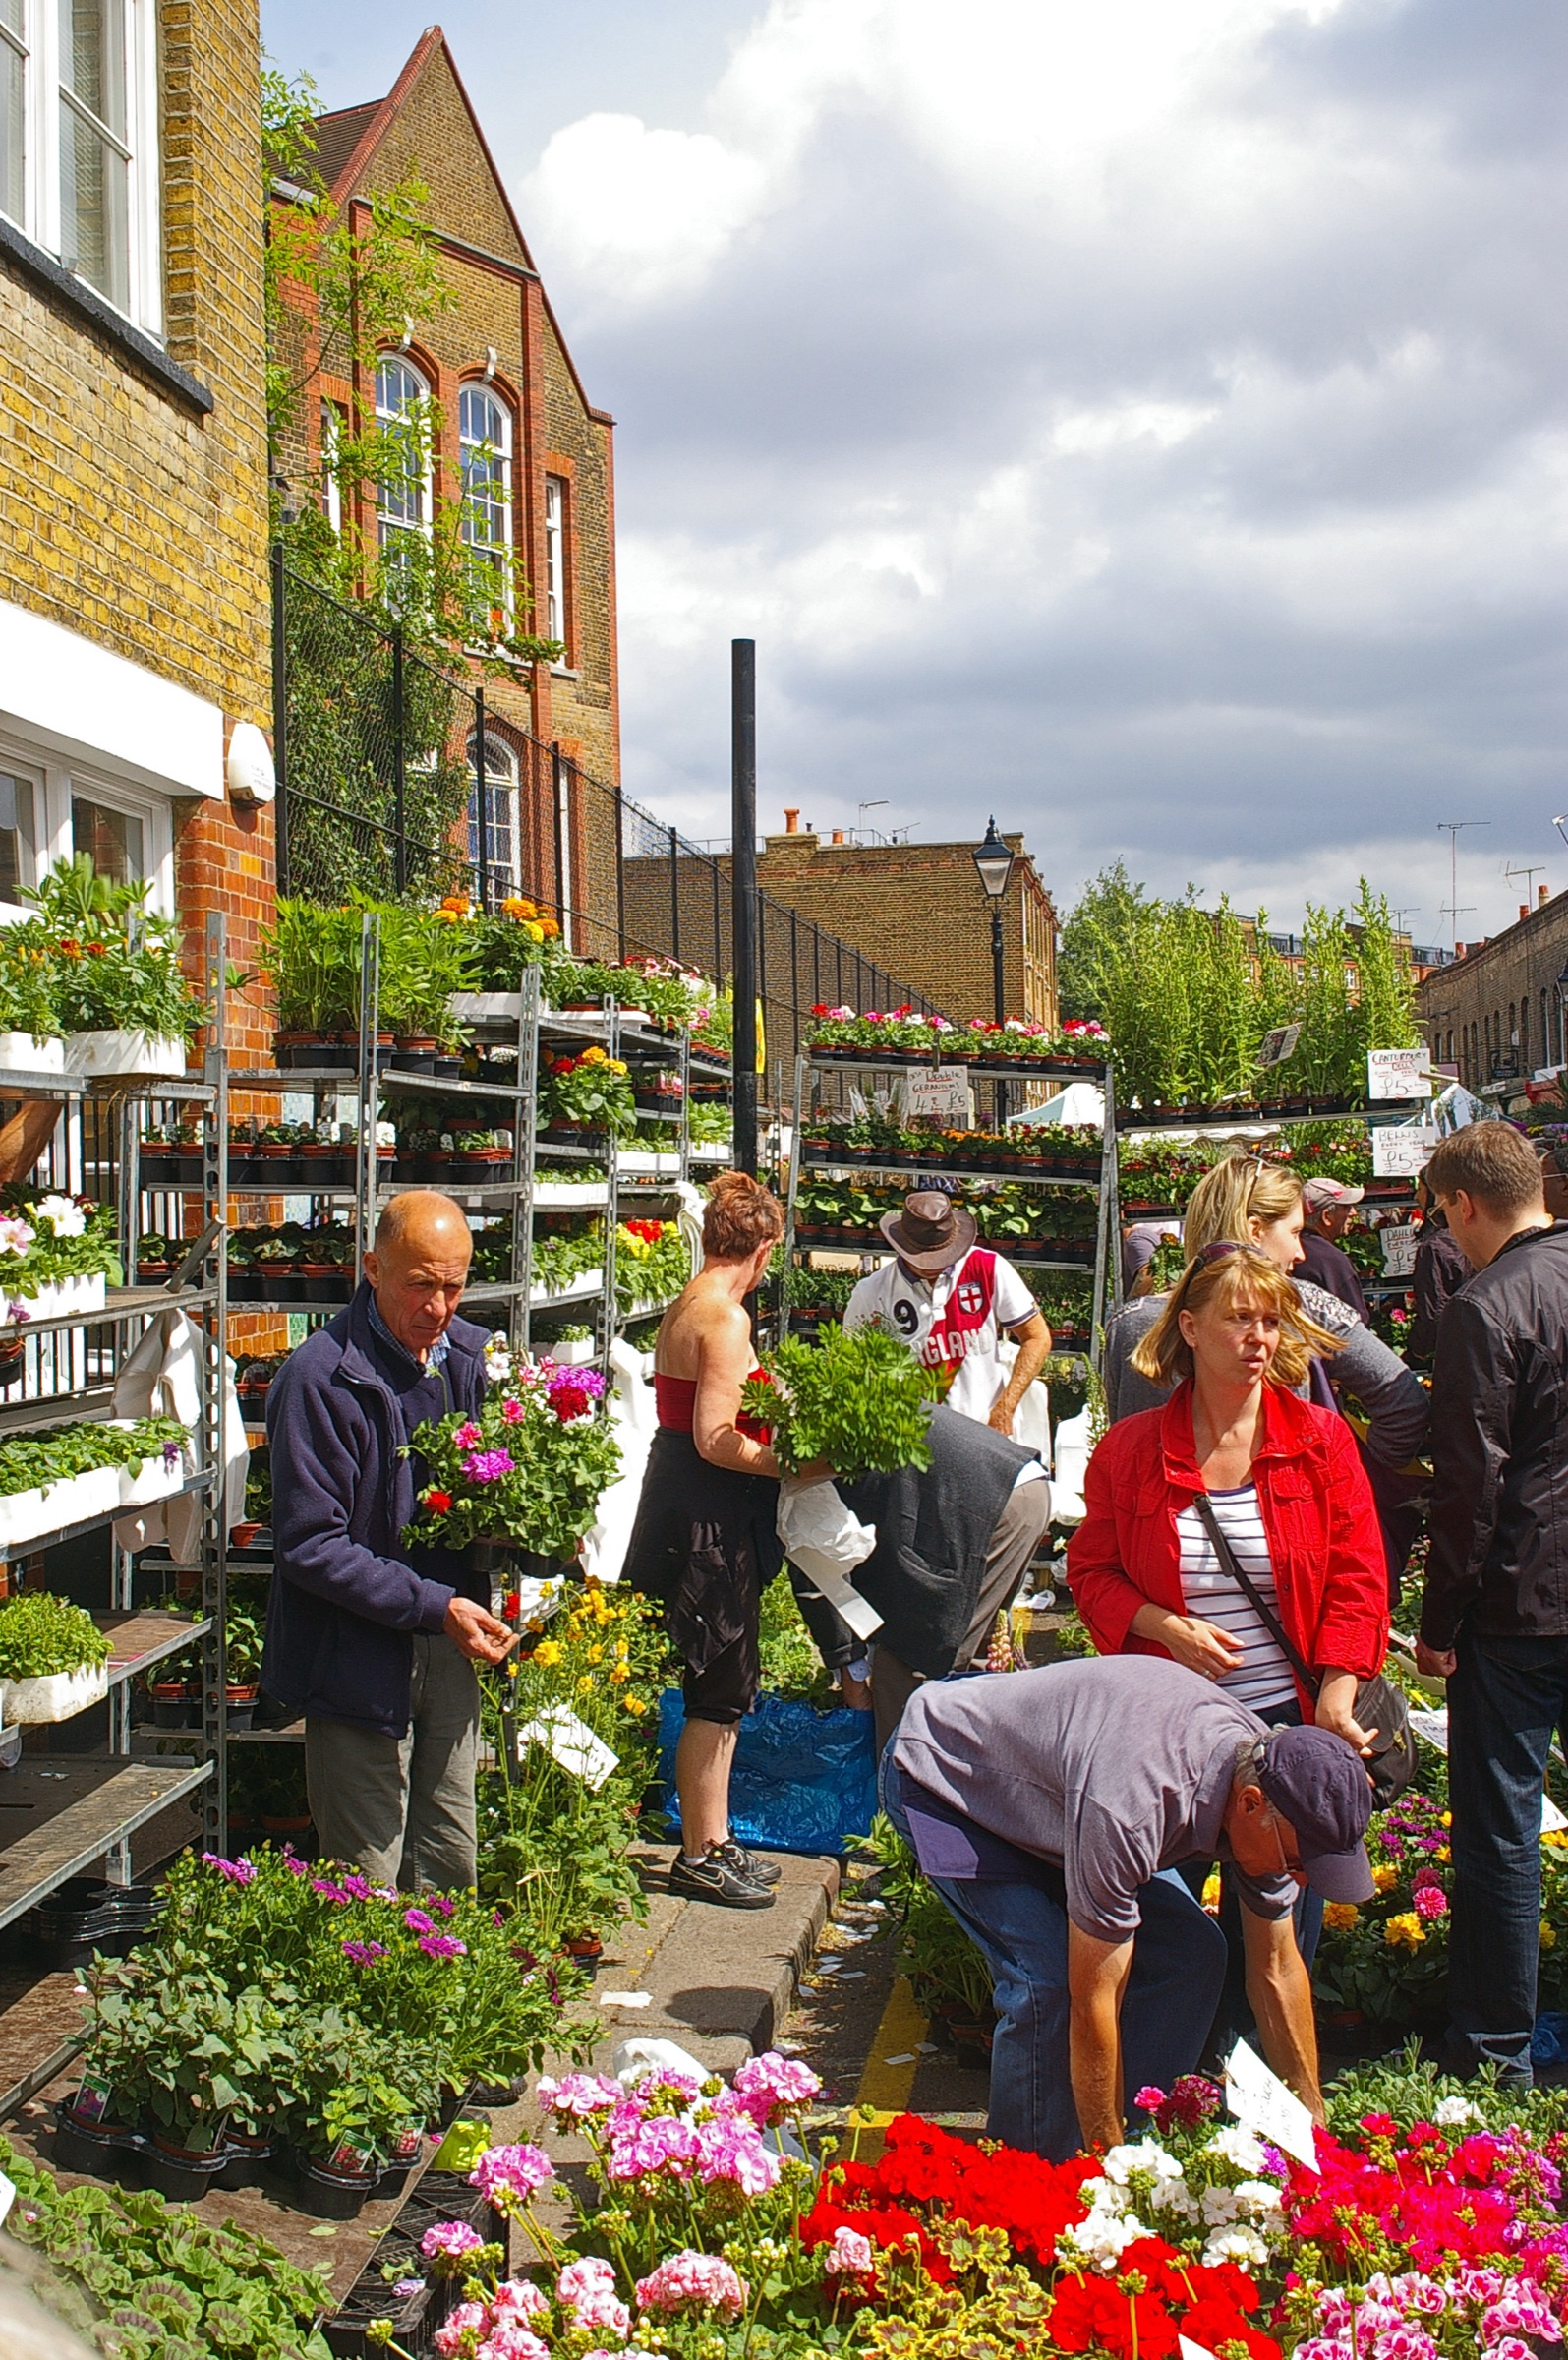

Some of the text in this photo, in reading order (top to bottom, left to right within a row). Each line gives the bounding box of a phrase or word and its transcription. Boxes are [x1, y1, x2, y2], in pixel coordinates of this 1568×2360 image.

[1379, 1077, 1409, 1097] £5
[915, 1094, 927, 1113] 4
[946, 1091, 965, 1111] £5
[1382, 1150, 1413, 1174] £5
[894, 1299, 919, 1335] 9
[909, 1326, 991, 1368] NGLAND
